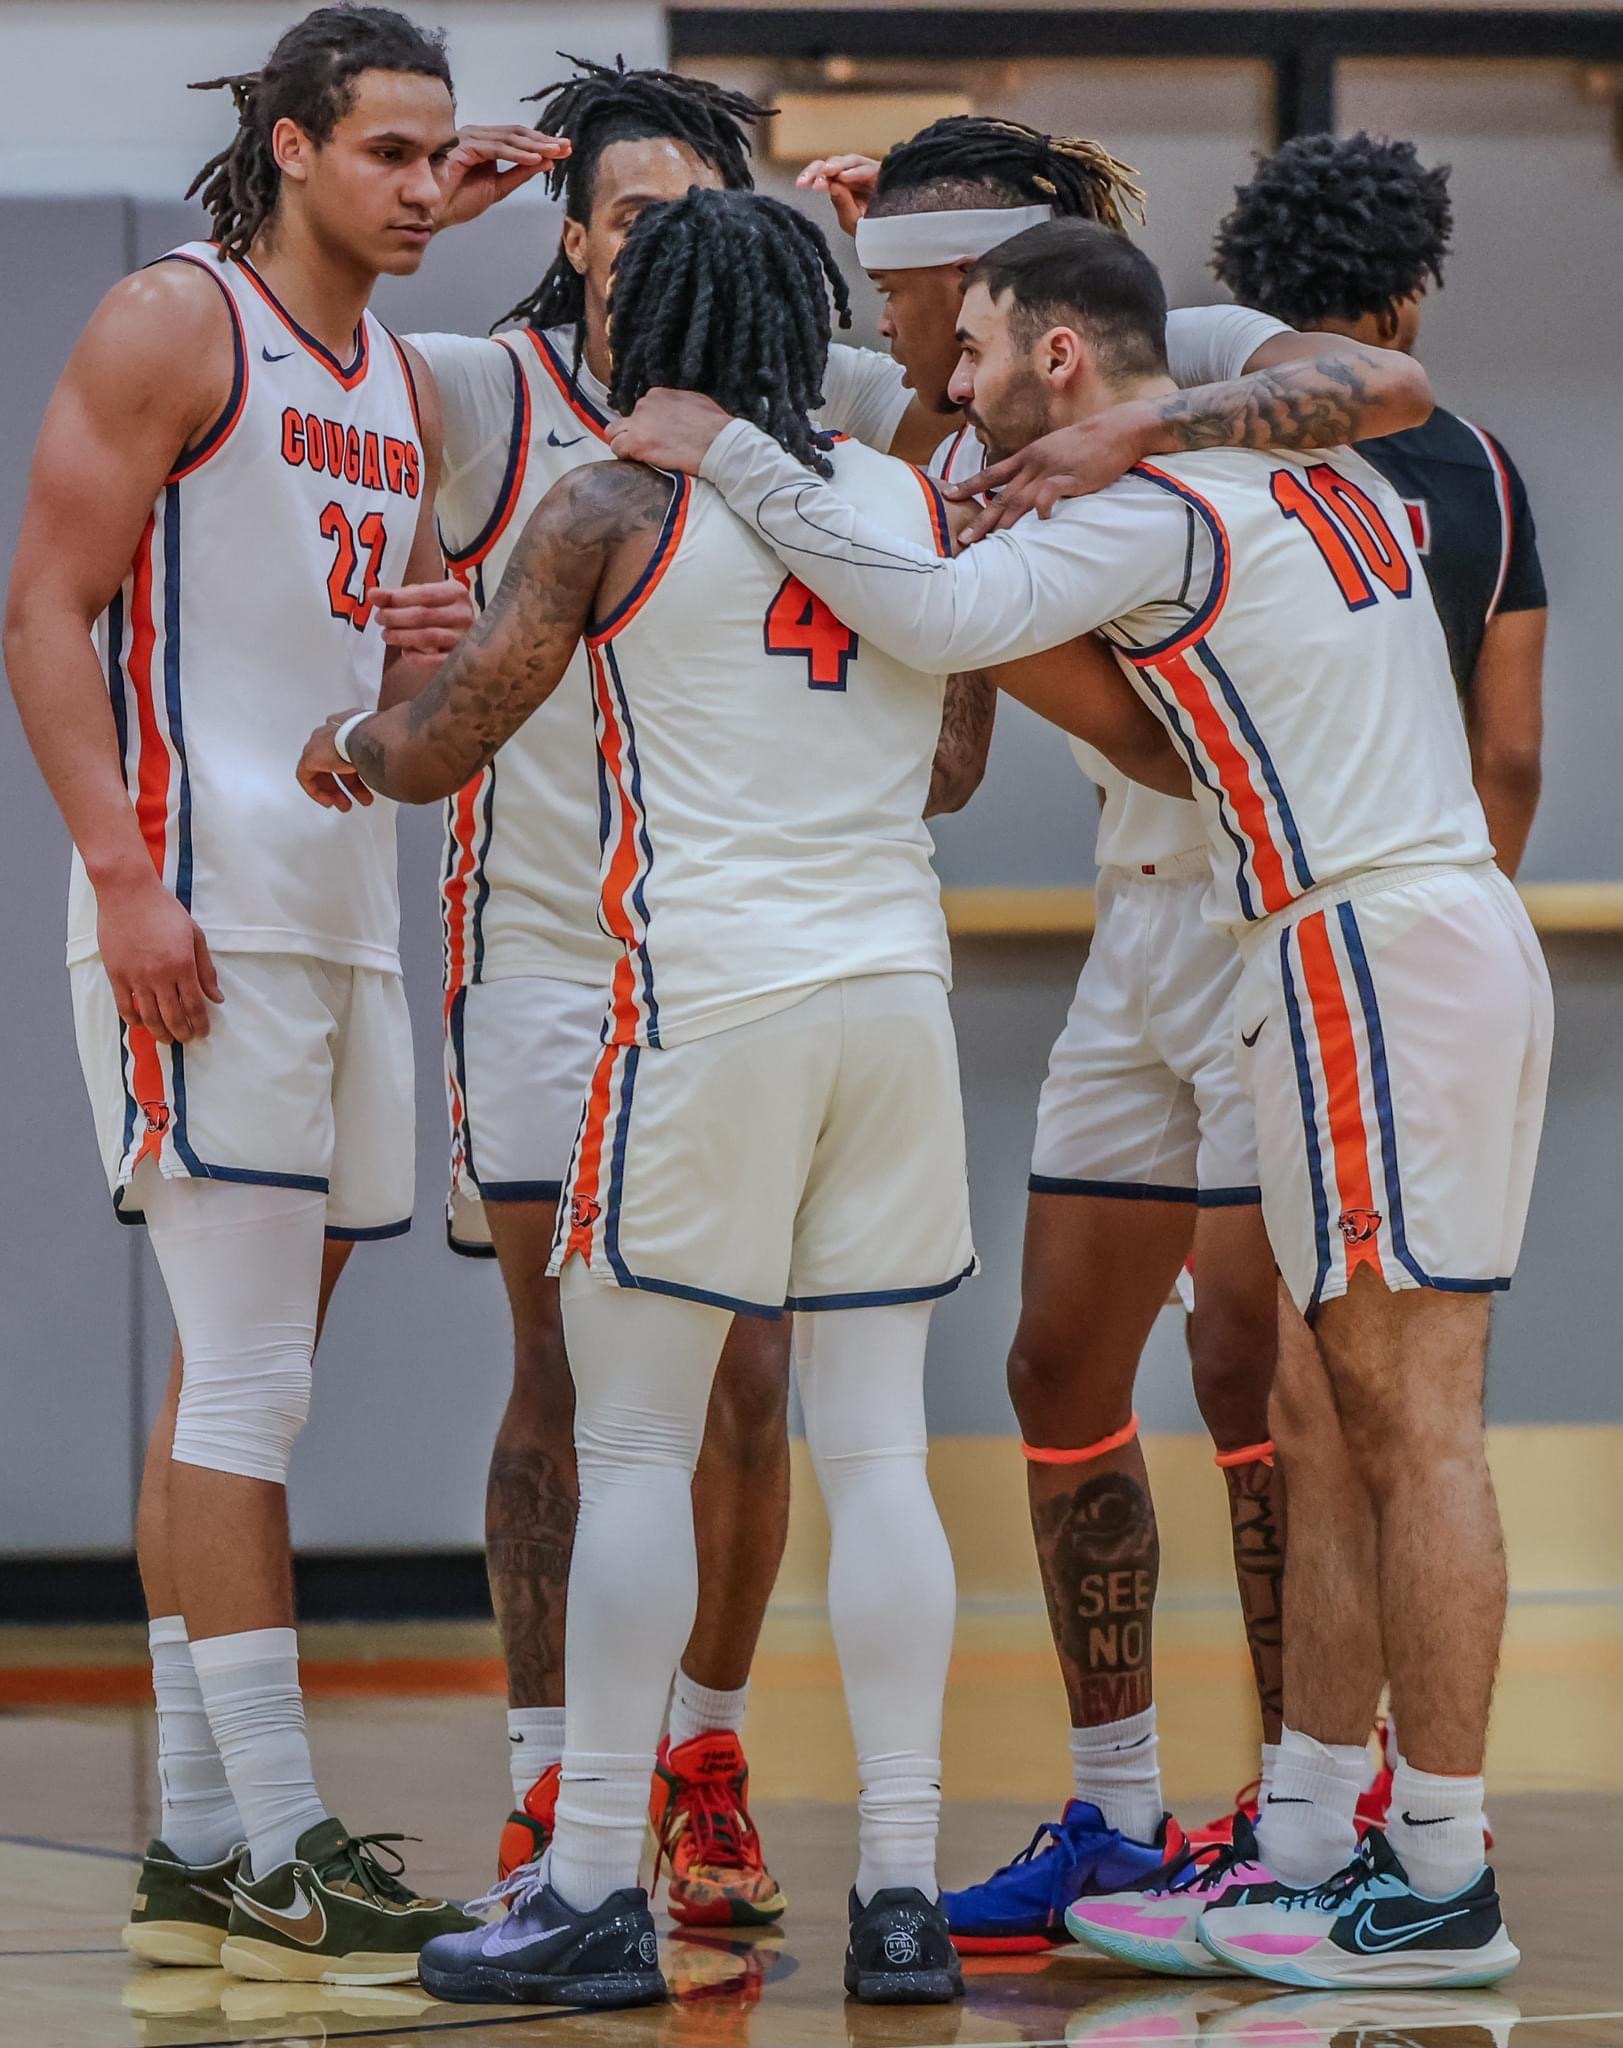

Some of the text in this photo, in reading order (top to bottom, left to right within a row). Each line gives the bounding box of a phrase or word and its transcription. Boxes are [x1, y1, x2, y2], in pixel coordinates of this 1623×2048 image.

[281, 406, 420, 500] COUGARS
[1269, 463, 1412, 613] 10
[763, 570, 859, 692] 4
[1078, 1570, 1150, 1618] SEE
[1088, 1621, 1144, 1669] NO
